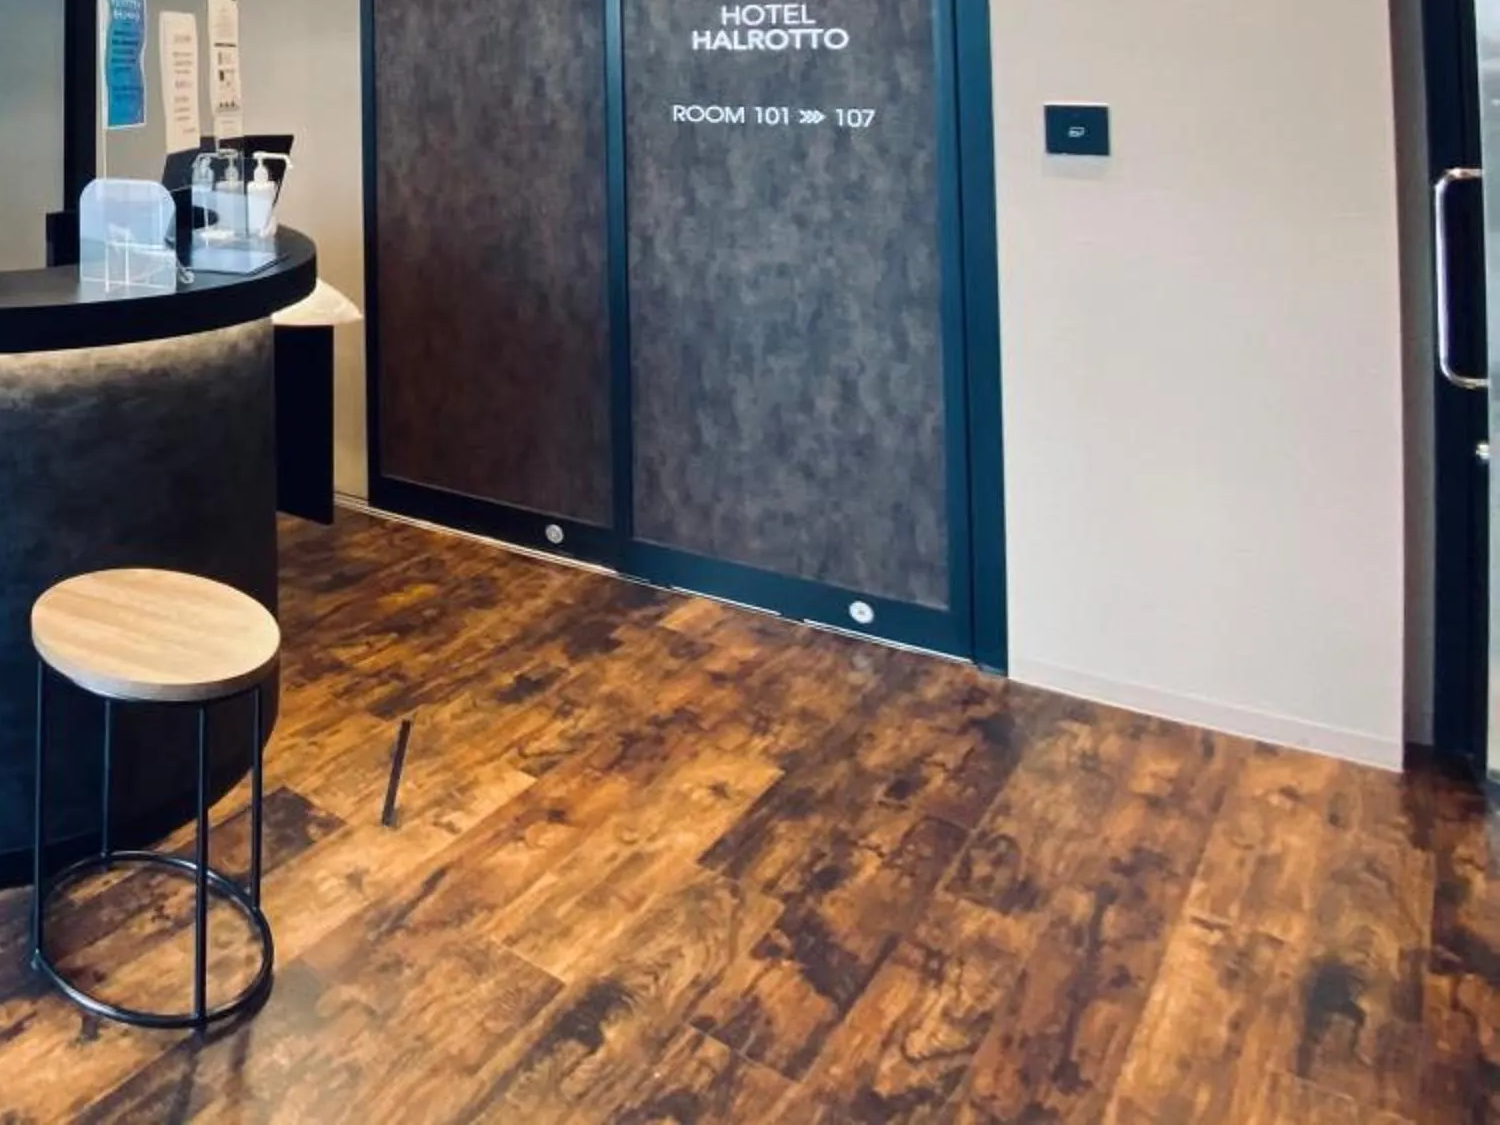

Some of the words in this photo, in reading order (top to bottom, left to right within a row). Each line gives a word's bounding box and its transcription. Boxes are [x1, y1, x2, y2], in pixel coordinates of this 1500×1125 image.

[721, 4, 815, 25] HOTEL
[692, 28, 849, 50] HALROTTO
[673, 105, 745, 123] ROOM
[755, 106, 789, 125] 101
[835, 108, 875, 127] 107
